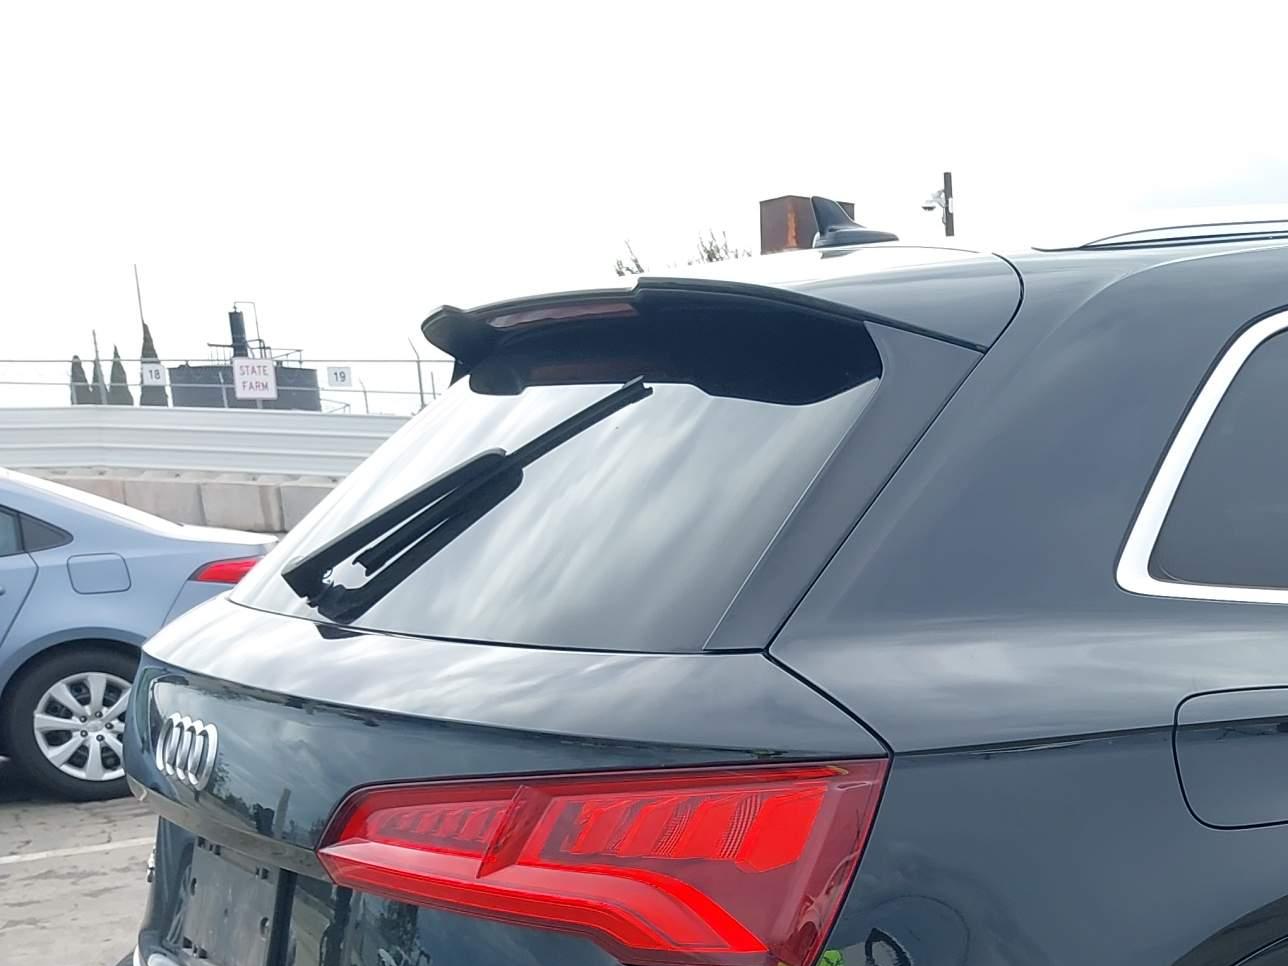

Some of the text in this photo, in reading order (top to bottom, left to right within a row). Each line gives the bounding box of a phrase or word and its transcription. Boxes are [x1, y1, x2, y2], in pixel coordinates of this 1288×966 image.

[148, 369, 160, 380] 18
[239, 364, 269, 376] STATE
[333, 371, 346, 382] 19
[242, 380, 269, 392] FARM
